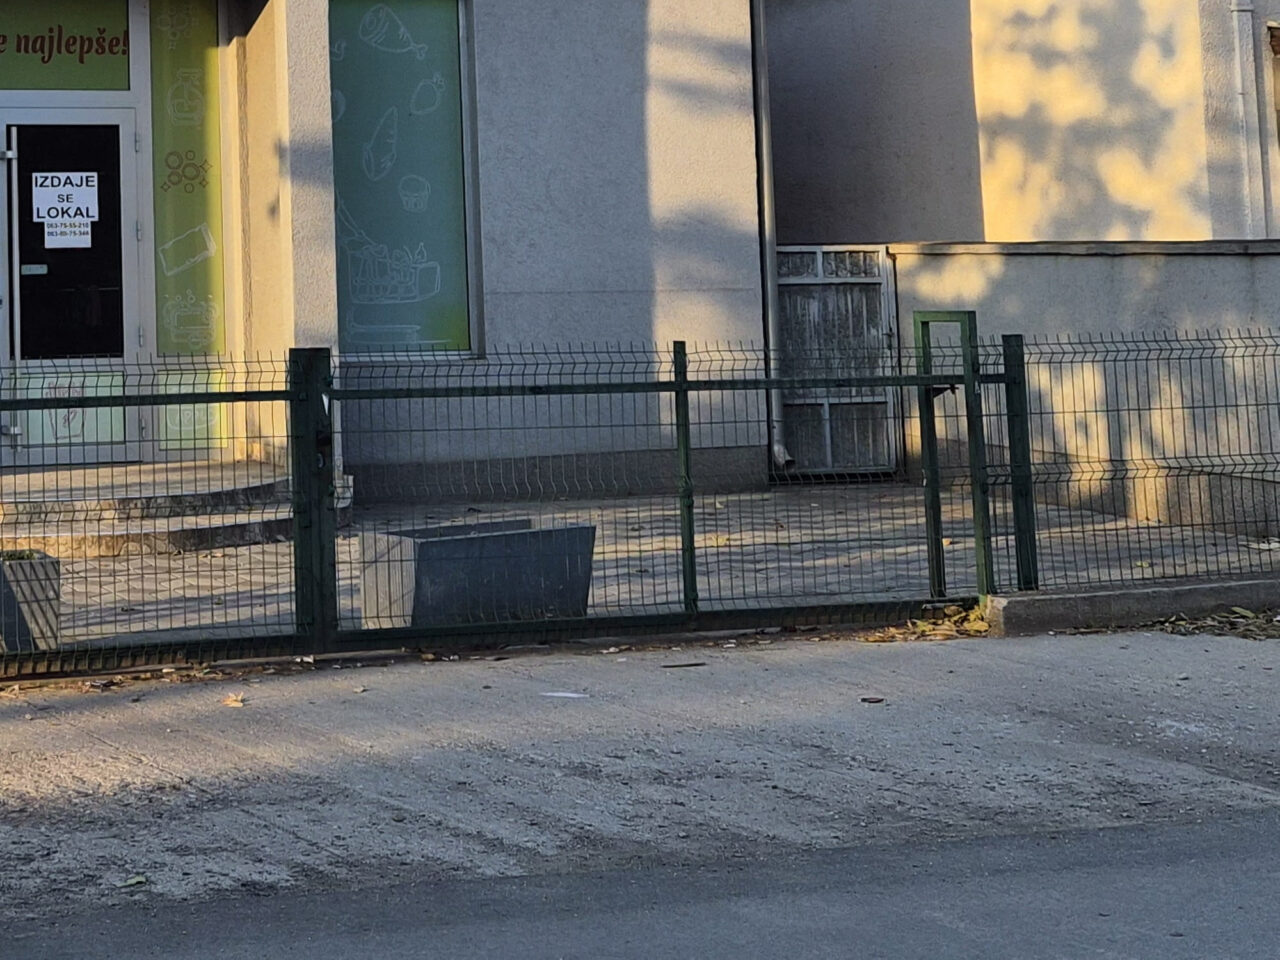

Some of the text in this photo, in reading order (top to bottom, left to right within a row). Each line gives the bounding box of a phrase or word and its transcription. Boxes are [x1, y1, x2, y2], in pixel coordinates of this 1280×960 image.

[15, 24, 128, 64] najlepše!
[34, 175, 95, 188] IZDAJE
[57, 194, 74, 203] SE
[36, 206, 95, 219] LOKAL
